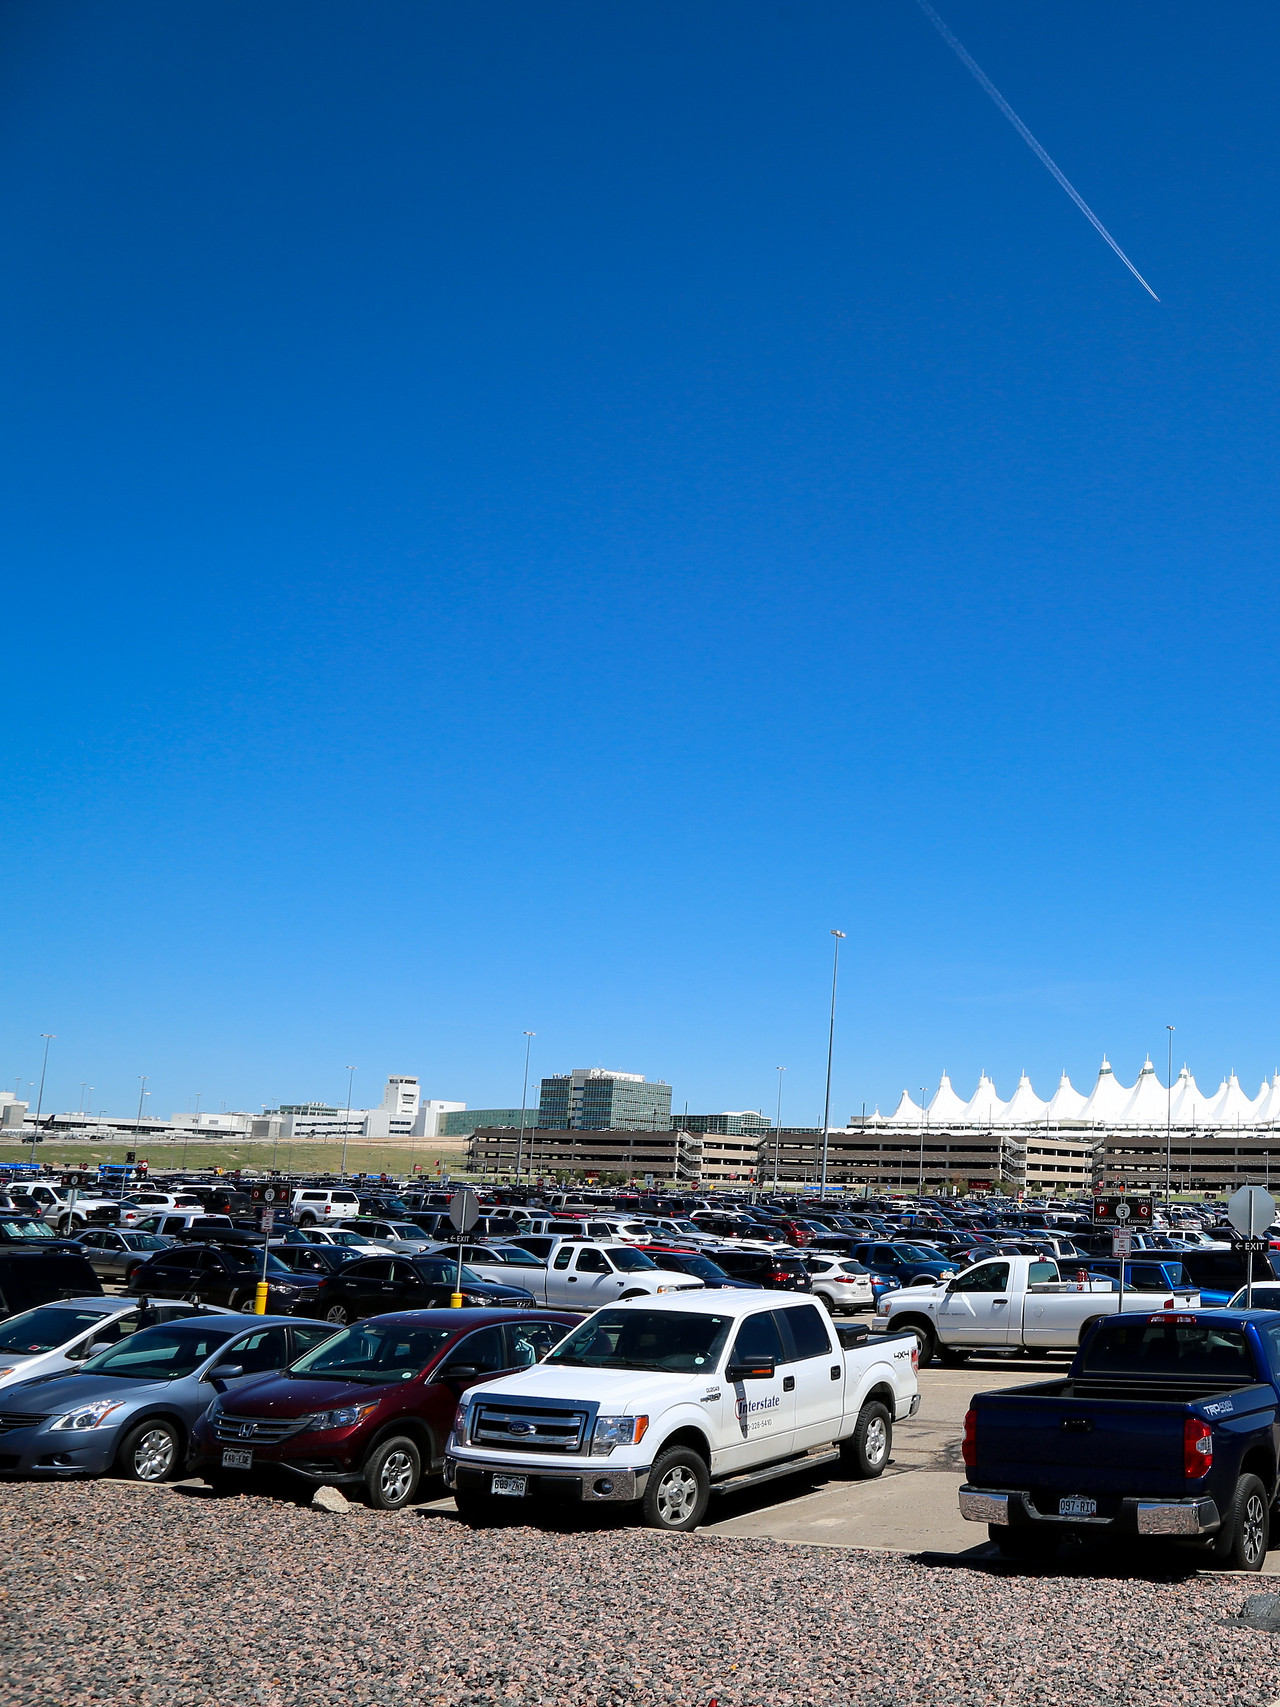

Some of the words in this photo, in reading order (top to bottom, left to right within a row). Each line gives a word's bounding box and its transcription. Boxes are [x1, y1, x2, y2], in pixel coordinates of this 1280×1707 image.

[1099, 1206, 1105, 1214] P
[1120, 1209, 1126, 1217] 3
[1140, 1206, 1148, 1216] Q
[456, 1235, 471, 1243] EXIT
[1244, 1242, 1265, 1251] EXIT
[739, 1396, 780, 1415] Interstate
[1203, 1403, 1220, 1416] TRD
